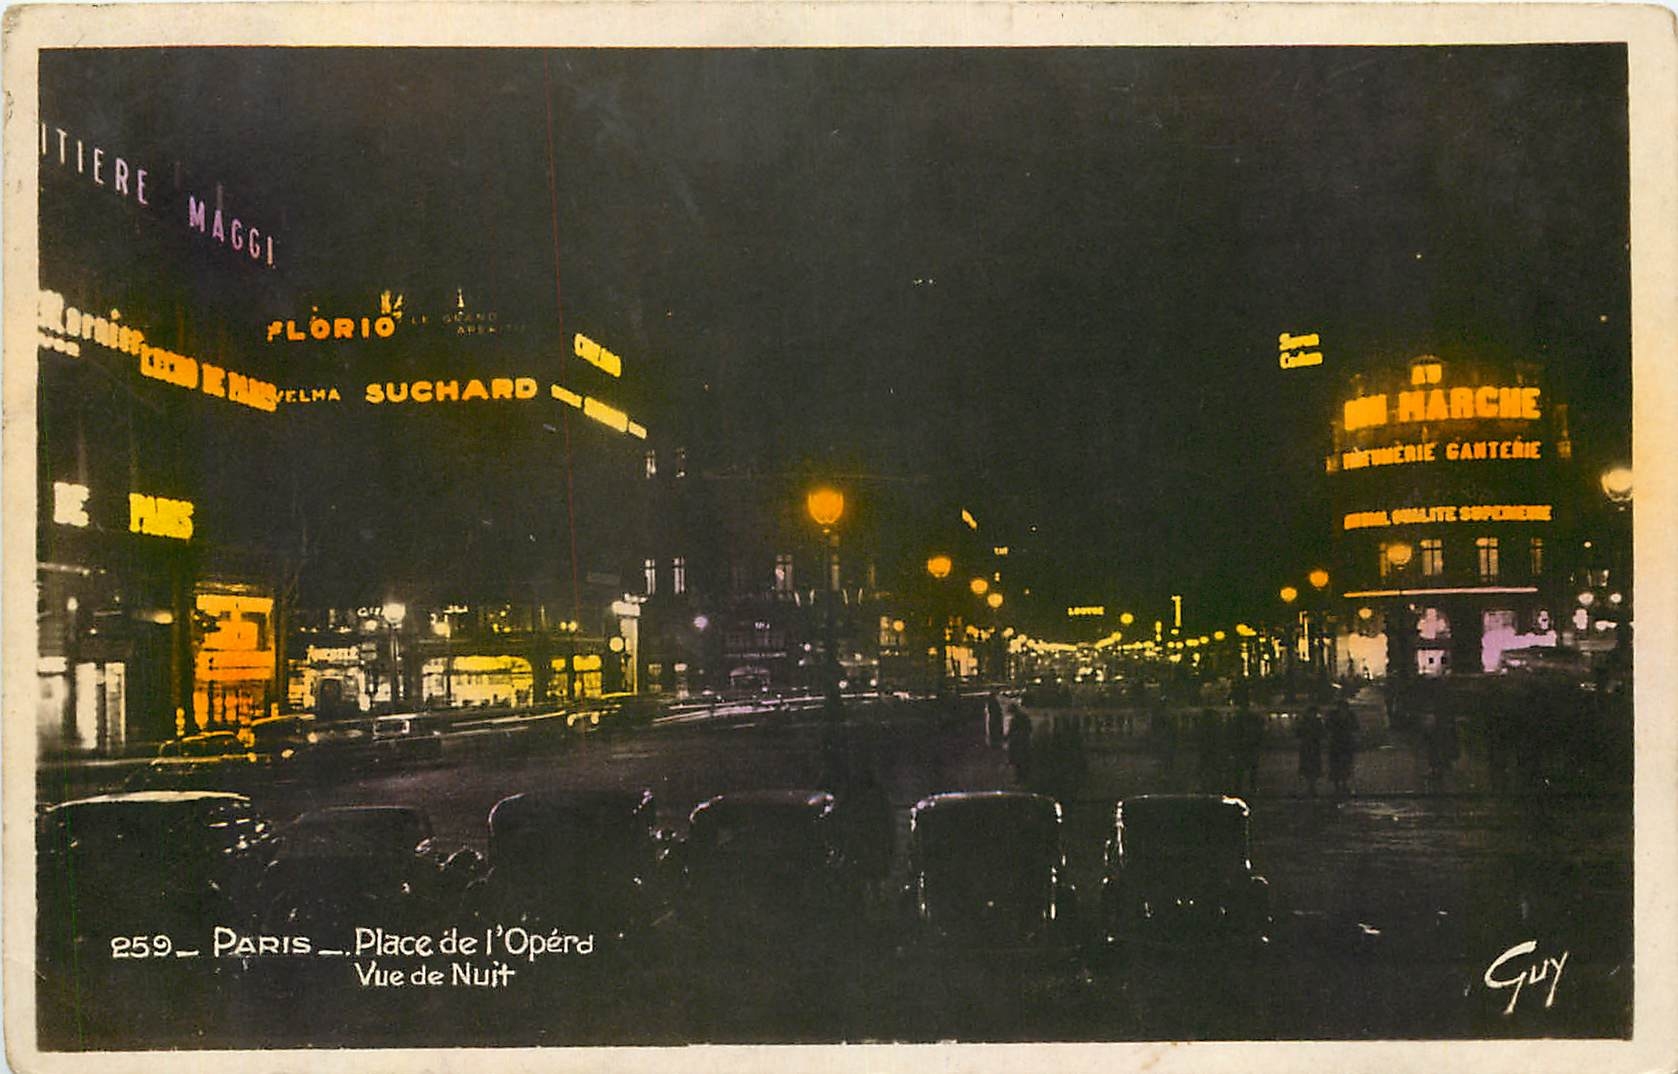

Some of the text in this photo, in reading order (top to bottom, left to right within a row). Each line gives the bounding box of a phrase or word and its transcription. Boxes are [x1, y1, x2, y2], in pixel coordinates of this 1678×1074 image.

[188, 195, 274, 266] MAGGI
[267, 316, 396, 342] FLORIO
[365, 377, 538, 405] SUCHARD
